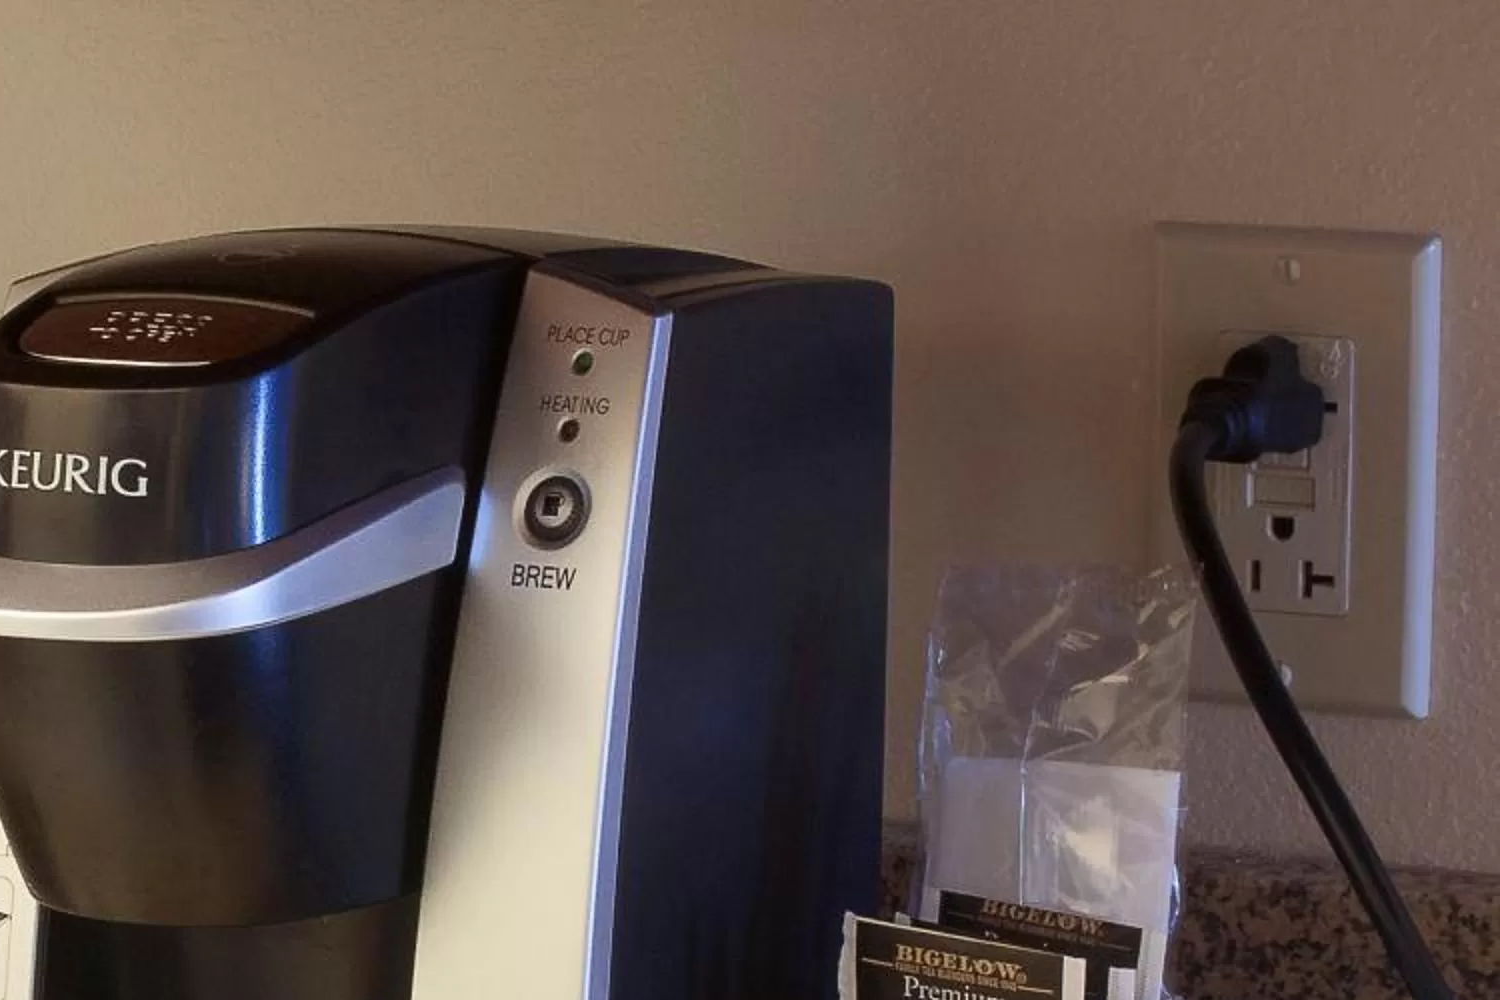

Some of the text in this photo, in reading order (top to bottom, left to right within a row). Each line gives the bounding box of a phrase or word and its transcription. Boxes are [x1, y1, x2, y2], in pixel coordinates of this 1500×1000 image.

[547, 324, 630, 347] PLACE CUP
[541, 395, 610, 415] HEATING
[511, 563, 577, 590] BREW
[981, 900, 1106, 936] BIGELOW
[895, 943, 1022, 981] BIGELOW
